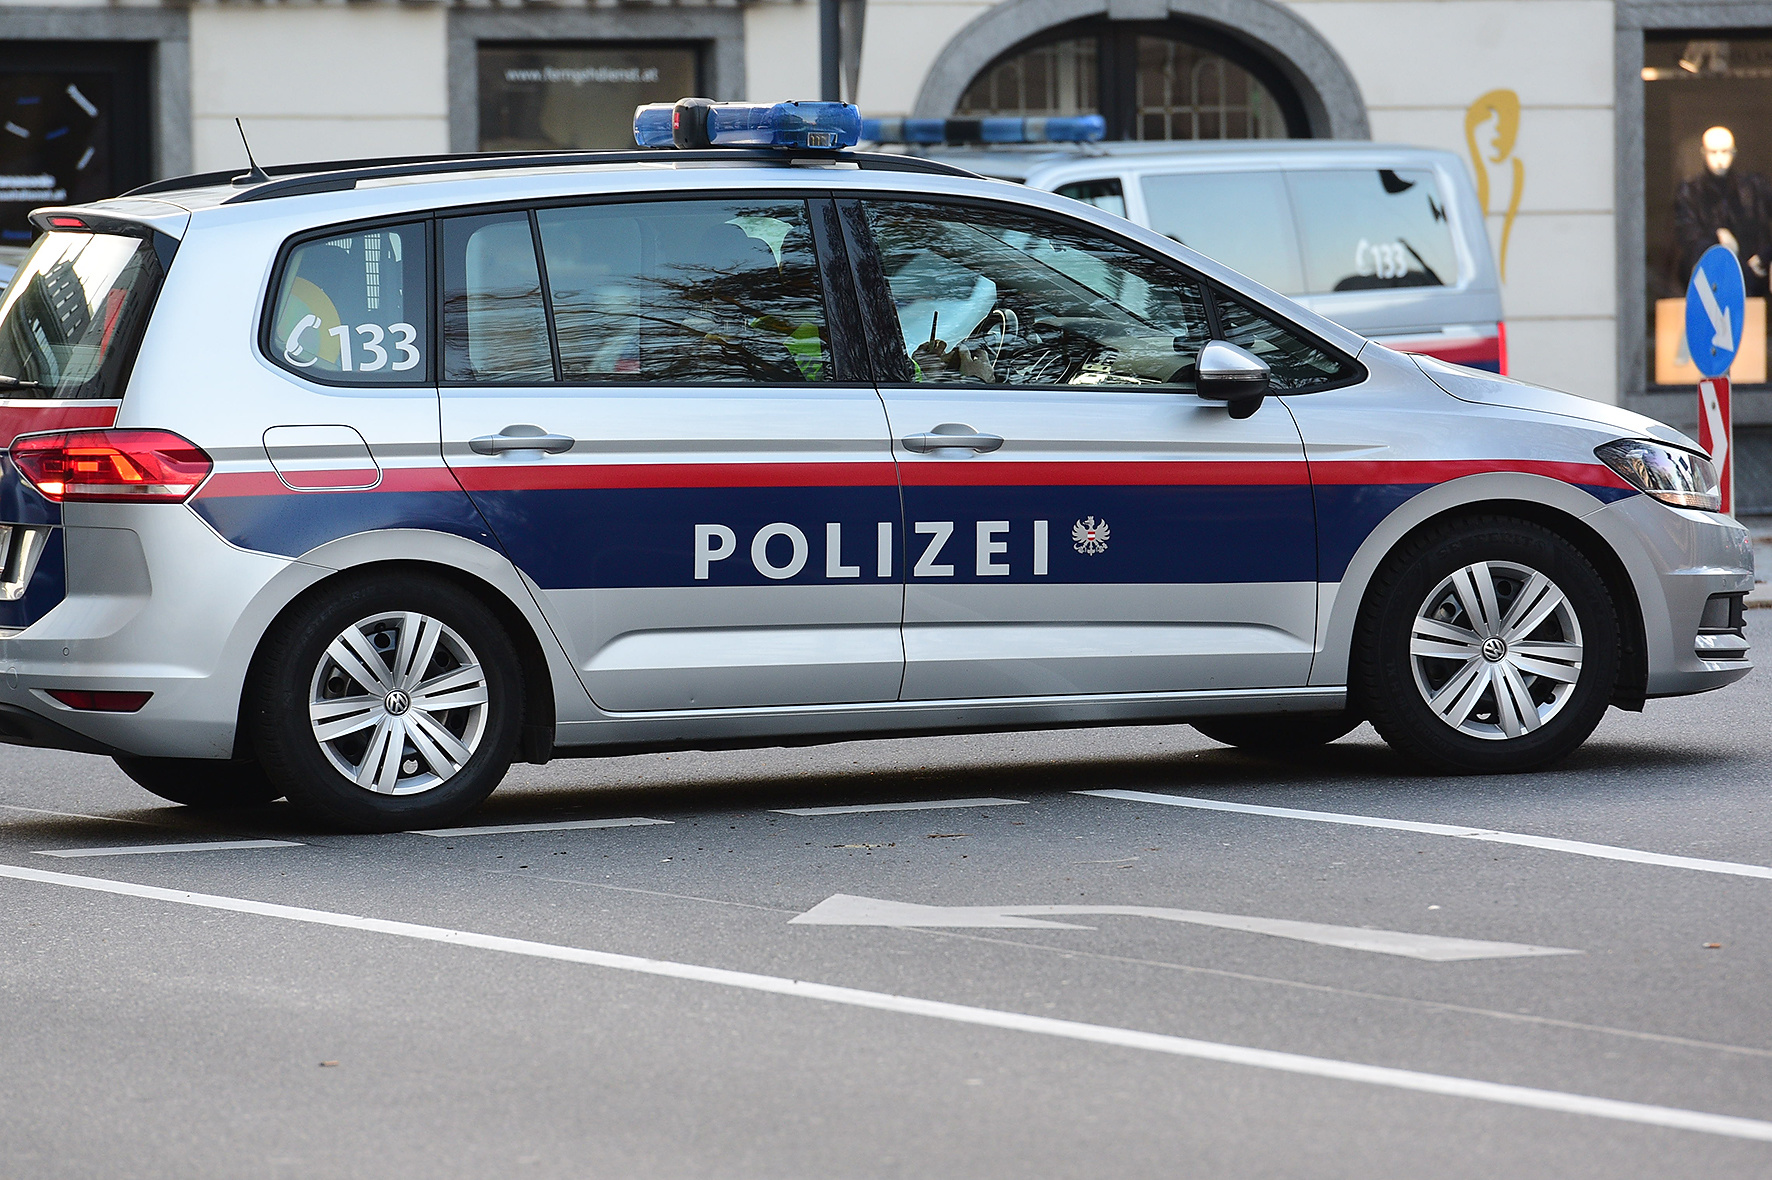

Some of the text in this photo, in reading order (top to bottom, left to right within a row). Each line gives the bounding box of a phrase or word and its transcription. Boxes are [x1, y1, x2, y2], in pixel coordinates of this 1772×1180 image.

[1371, 243, 1407, 279] 133
[328, 323, 421, 372] 133
[694, 520, 1048, 580] POLIZEI
